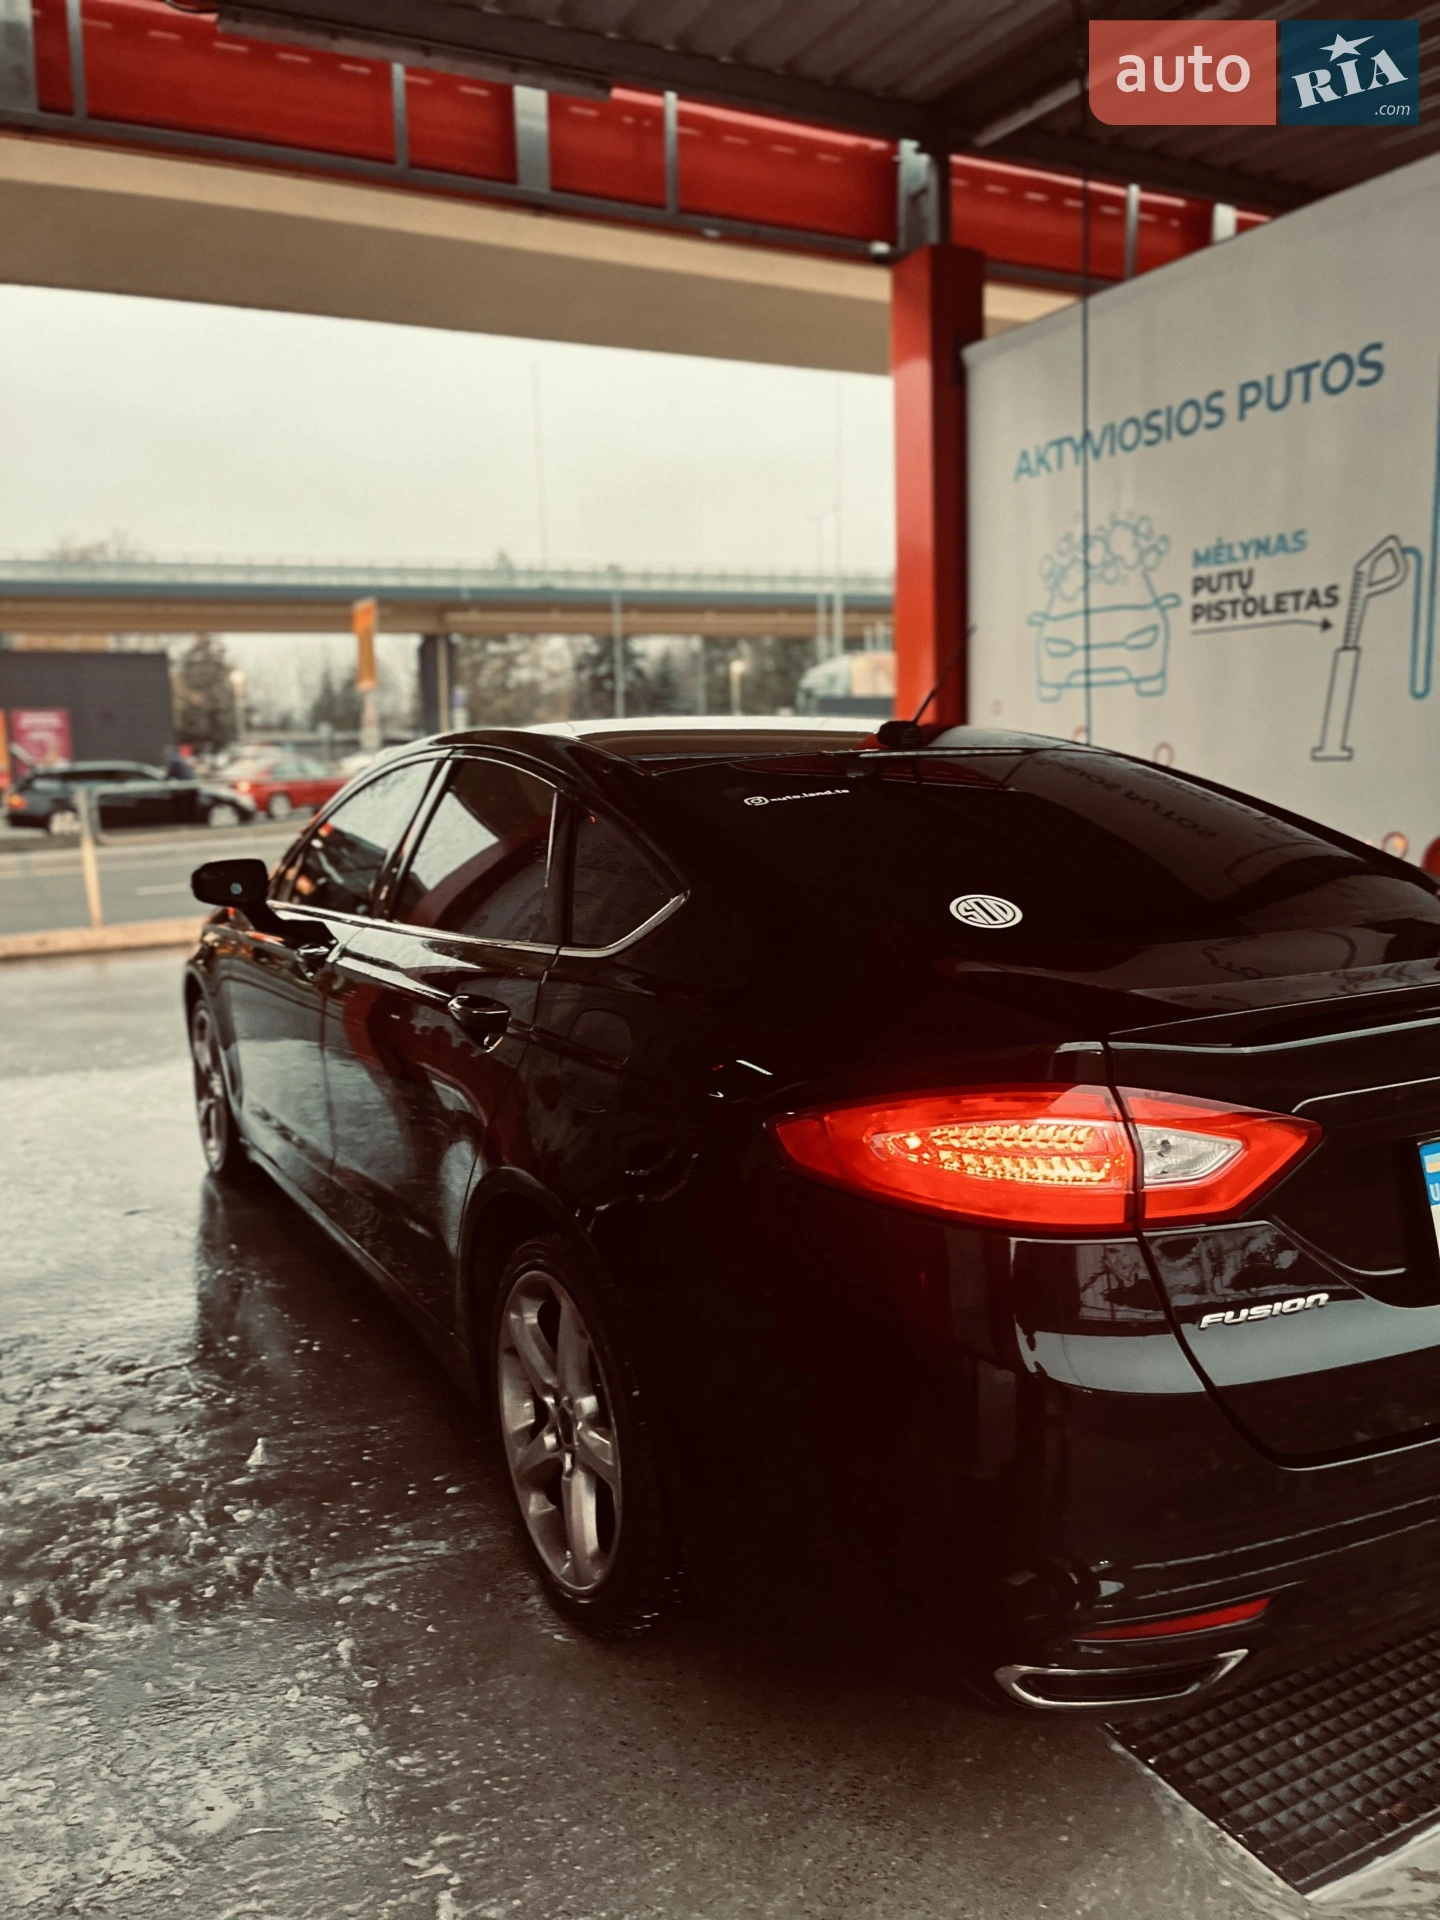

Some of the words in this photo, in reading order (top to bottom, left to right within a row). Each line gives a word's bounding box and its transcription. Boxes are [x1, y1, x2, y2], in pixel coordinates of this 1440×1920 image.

[1013, 389, 1226, 483] AKTYVIOSIOS
[1237, 342, 1385, 422] PUTOS
[1192, 529, 1308, 570] MĖLYNAS
[1192, 567, 1254, 602] PUTŲ
[1191, 584, 1341, 624] PISTOLETAS
[1429, 1182, 1440, 1203] U
[1199, 1292, 1330, 1329] FUSION
